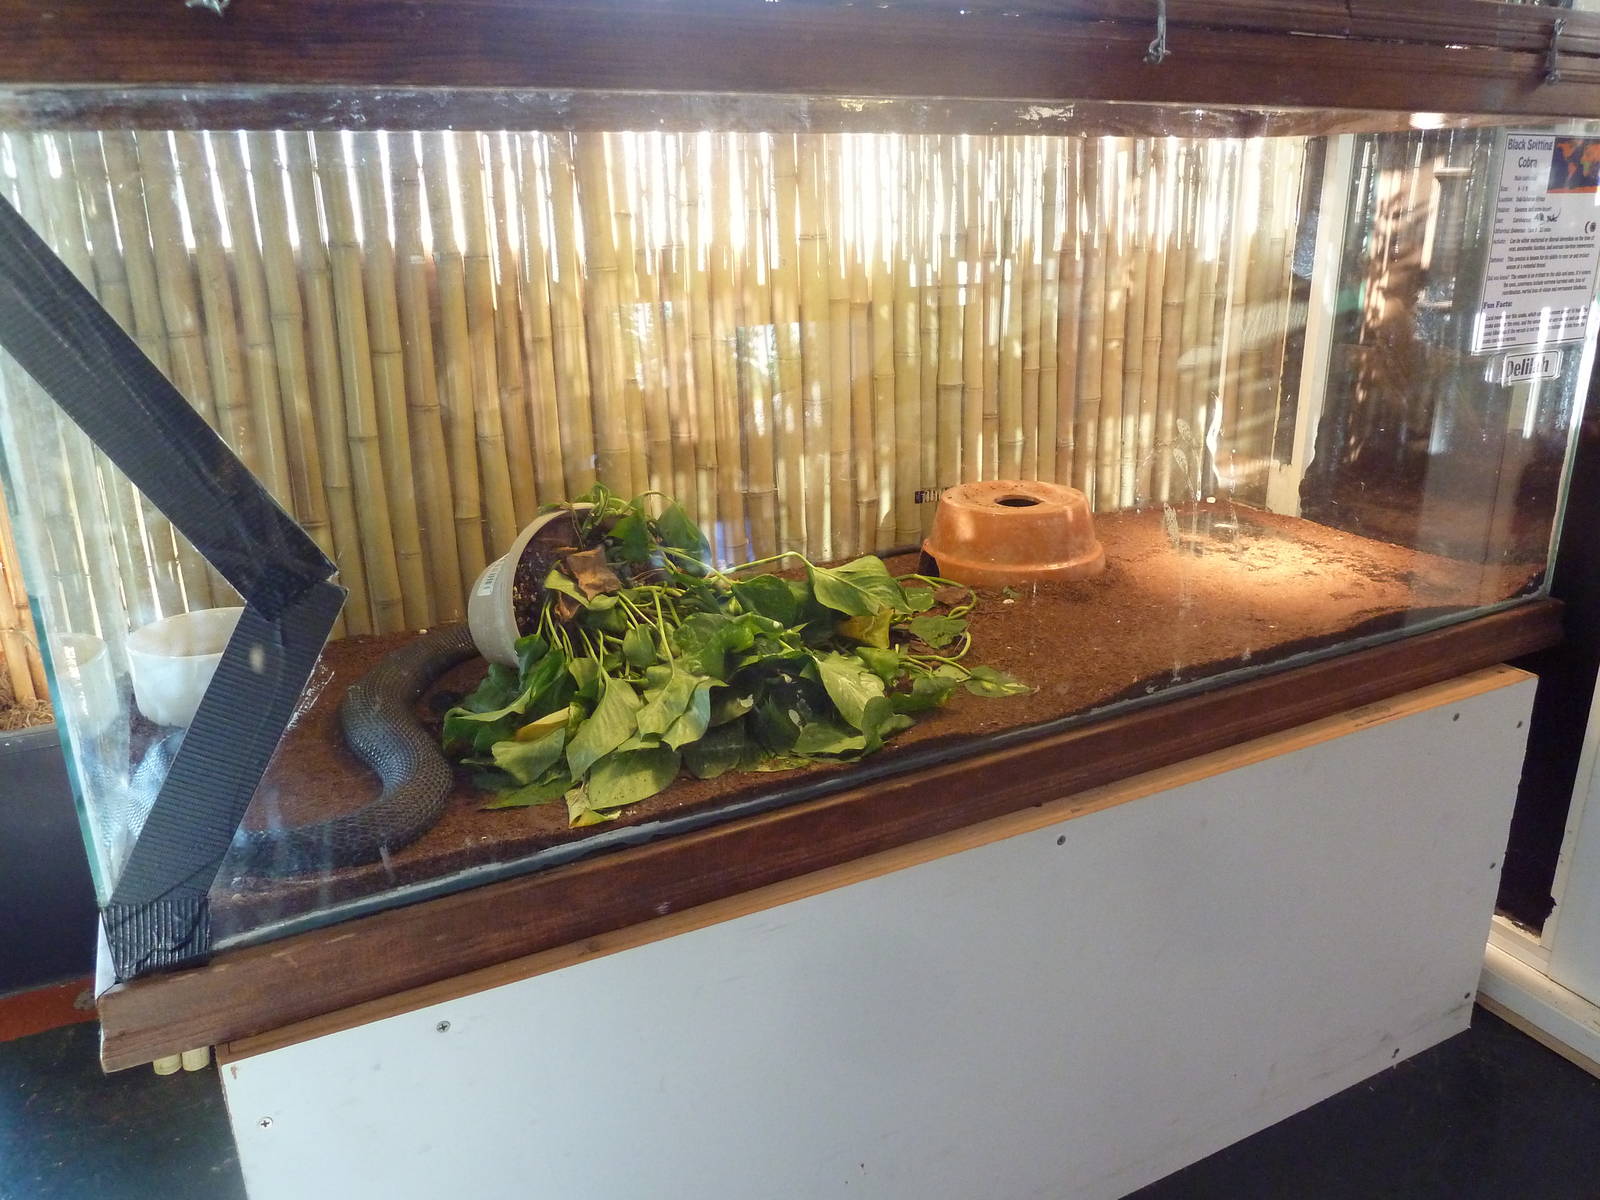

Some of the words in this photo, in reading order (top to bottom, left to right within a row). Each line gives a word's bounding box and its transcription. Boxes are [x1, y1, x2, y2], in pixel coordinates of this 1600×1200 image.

[1507, 138, 1526, 151] Black
[1527, 139, 1553, 151] Spitting
[1518, 156, 1538, 168] Cobra
[1483, 301, 1495, 309] Fun
[1506, 355, 1549, 377] Delilh
